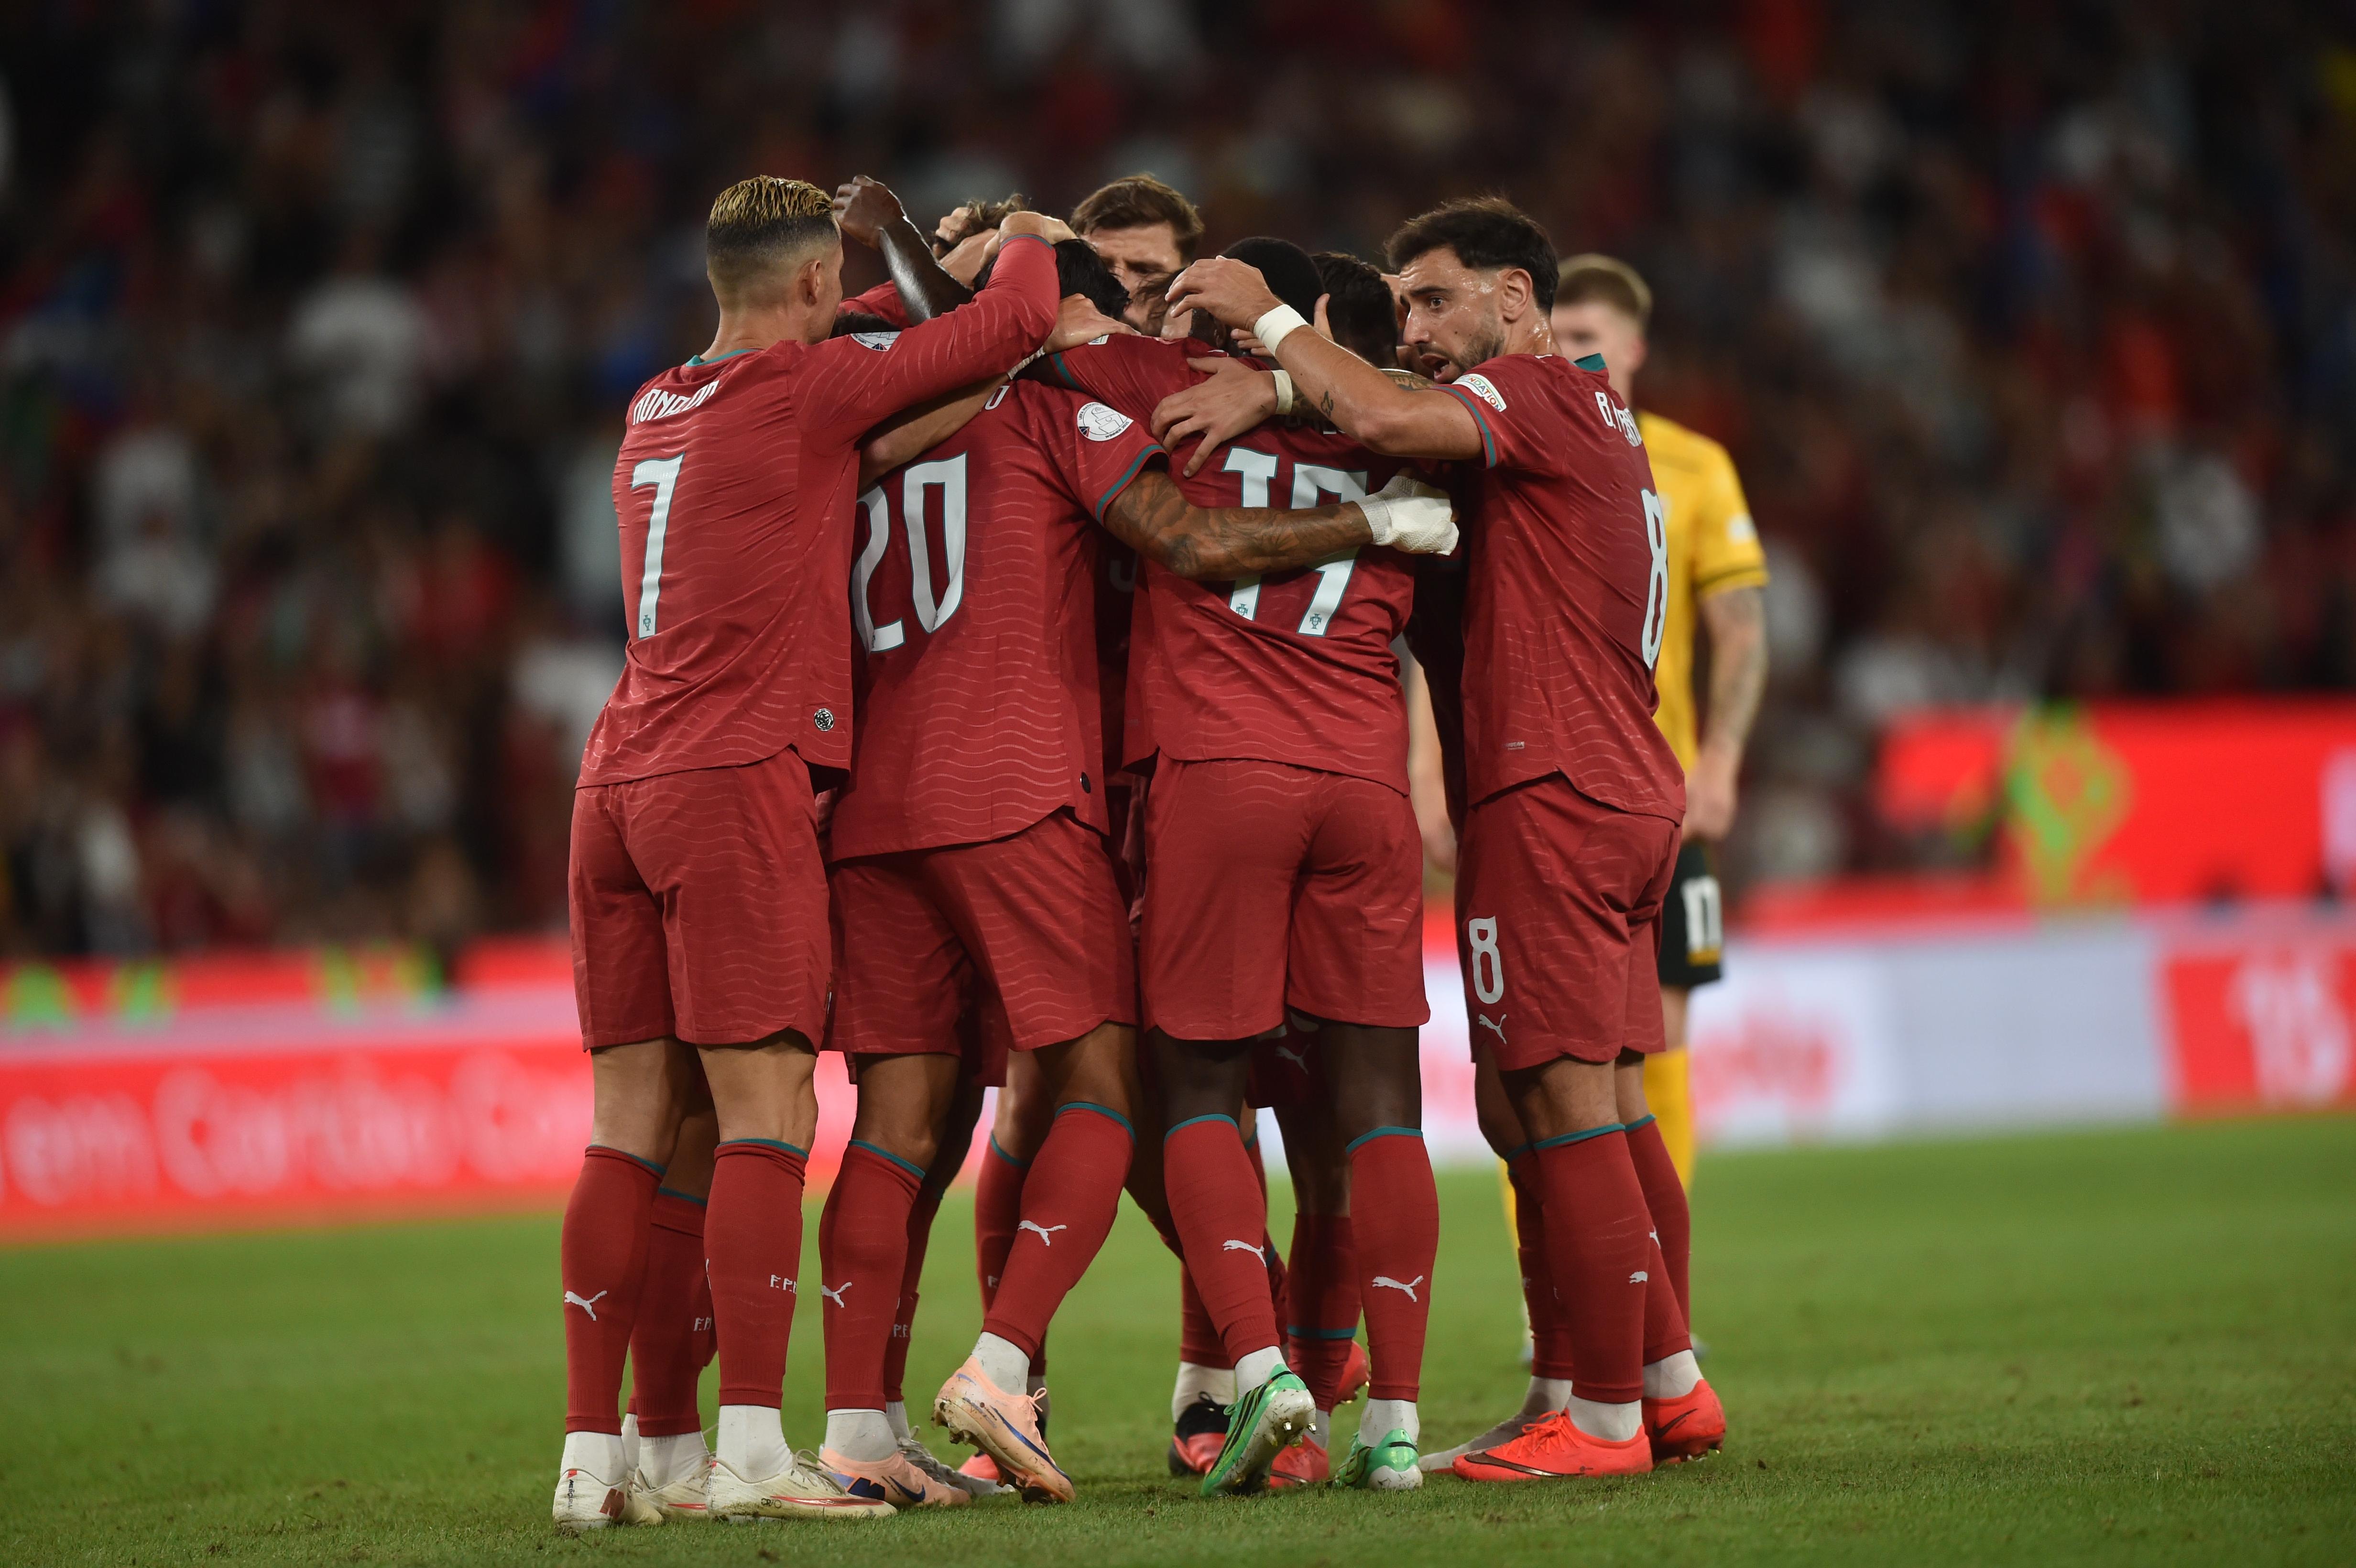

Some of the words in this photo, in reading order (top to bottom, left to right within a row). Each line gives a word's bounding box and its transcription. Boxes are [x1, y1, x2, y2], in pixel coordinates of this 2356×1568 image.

[631, 451, 685, 640] 7
[853, 450, 968, 659] 20
[1221, 446, 1368, 637] 17
[1641, 487, 1668, 670] 8
[1468, 916, 1505, 1005] 8
